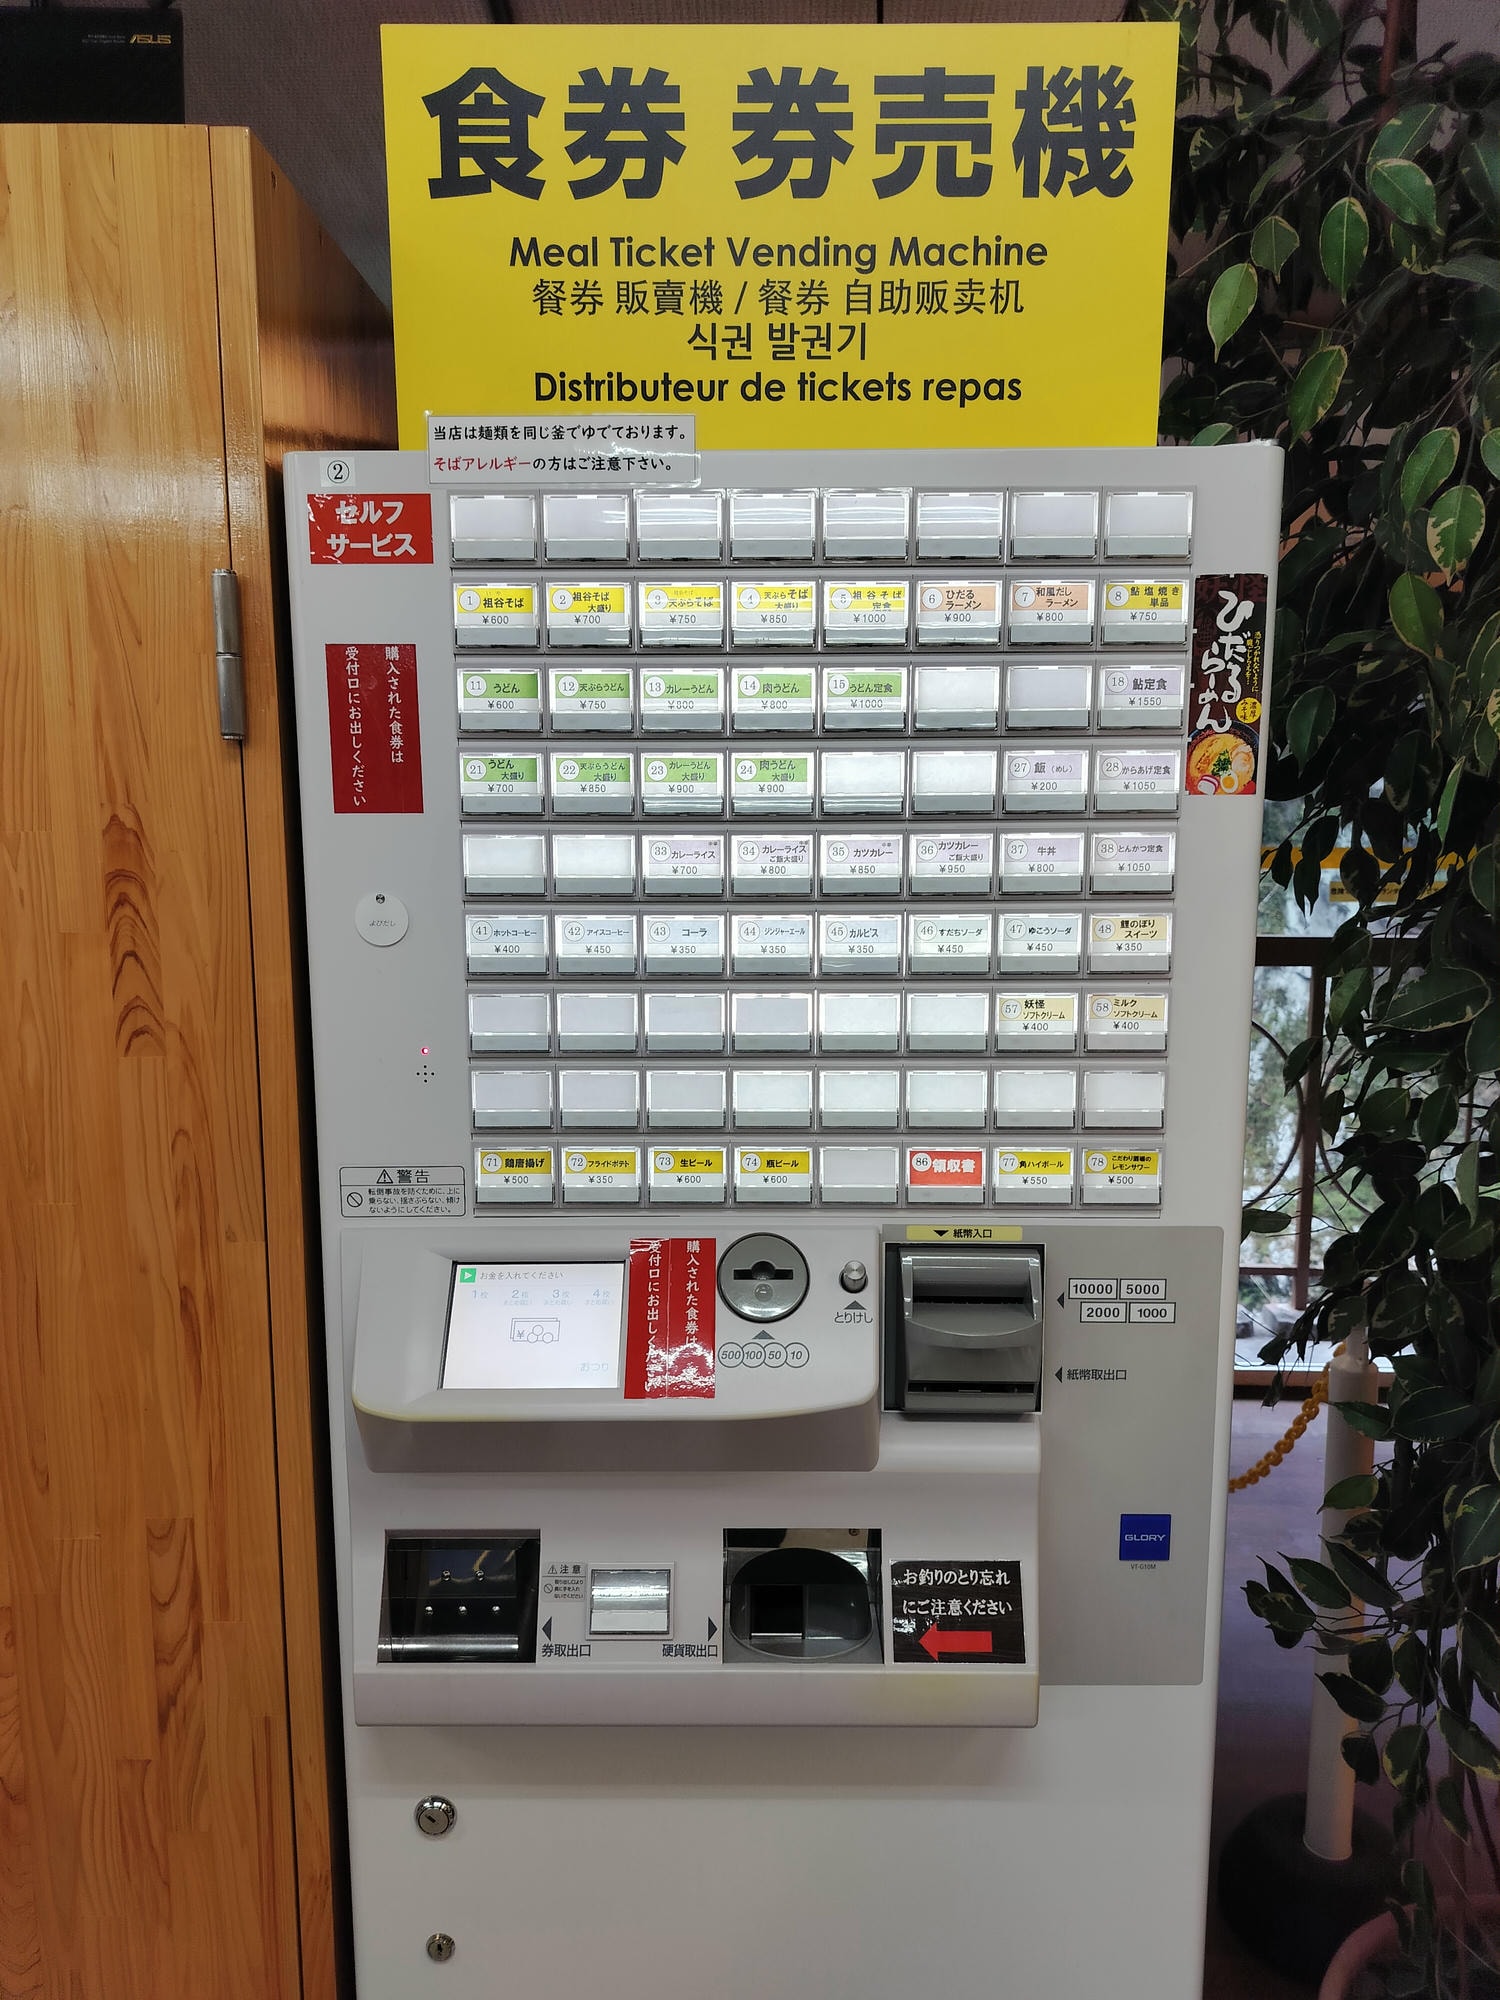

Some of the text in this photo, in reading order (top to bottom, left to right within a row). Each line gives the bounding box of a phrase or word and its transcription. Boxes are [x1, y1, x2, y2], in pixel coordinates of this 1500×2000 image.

[129, 34, 171, 44] ASUS
[421, 64, 1137, 200] 食券 券売機
[509, 235, 1048, 274] Meal Ticket Vending Machine
[532, 278, 604, 316] 餐券
[615, 279, 723, 316] 販賣機
[758, 278, 830, 315] 餐券
[845, 278, 1024, 315] 自助贩卖机
[687, 323, 866, 360] 식권 발권기
[535, 371, 1022, 409] Distributeur de tickets repas
[433, 425, 687, 441] 当店は麺類を同じ釜でゆでております。
[433, 456, 673, 472] そばアレルギーの方はご注意下さい。
[335, 500, 404, 525] セルフ
[327, 533, 416, 558] サービス
[764, 589, 808, 600] 天ぷらそば
[946, 589, 975, 600] ひだる
[1036, 587, 1072, 596] 和風だし
[572, 591, 610, 602] 祖谷そば
[483, 597, 524, 608] 祖谷そば
[945, 601, 981, 610] ラーメン
[1046, 599, 1078, 608] ラーメン
[587, 604, 612, 614] 大盛り
[482, 615, 509, 625] ¥600
[574, 615, 601, 625] ¥700
[669, 614, 697, 624] ¥750
[760, 614, 787, 624] ¥850
[853, 614, 886, 623] ¥1000
[944, 613, 972, 622] ¥900
[1037, 612, 1064, 621] ¥800
[1130, 612, 1157, 620] ¥750
[493, 683, 520, 694] うどん
[579, 682, 625, 693] 天ぷらうどん
[666, 683, 714, 694] カレーうどん
[762, 683, 800, 694] 肉うどん
[849, 683, 893, 694] うどん定食
[1132, 678, 1168, 690] 鮎定食
[385, 645, 404, 764] 購入された食券は
[487, 700, 514, 710] ¥600
[580, 700, 606, 710] ¥750
[1129, 697, 1162, 706] ¥1550
[345, 646, 366, 807] 受付口にお出しください
[488, 759, 514, 769] うどん
[580, 762, 626, 771] 天ぷらうどん
[669, 760, 711, 770] カレーうどん
[759, 760, 796, 770] 肉うどん
[1122, 764, 1171, 775] からあげ定食
[501, 772, 524, 780] 大盛り
[593, 773, 617, 782] 大盛り
[681, 772, 705, 781] 大盛り
[772, 772, 795, 782] 大盛り
[488, 784, 514, 792] ¥700
[580, 784, 606, 792] ¥850
[668, 784, 694, 793] ¥900
[758, 784, 784, 792] ¥900
[1032, 782, 1058, 790] ¥200
[1124, 782, 1156, 790] ¥1050
[762, 844, 807, 854] カレーライス
[938, 842, 978, 850] カツカレー
[1118, 844, 1164, 852] とんかつ定食
[672, 850, 716, 860] カレーライス
[853, 848, 893, 858] カツカレー
[672, 866, 698, 874] ¥700
[760, 866, 786, 874] ¥800
[850, 865, 876, 874] ¥850
[939, 864, 966, 874] ¥950
[1028, 864, 1054, 872] ¥800
[1118, 863, 1150, 872] ¥1050
[682, 928, 708, 937] コーラ
[938, 928, 983, 936] すだちソーダ
[1124, 930, 1158, 939] スイーツ
[494, 945, 520, 954] ¥400
[585, 946, 611, 954] ¥450
[670, 946, 696, 954] ¥350
[760, 946, 786, 954] ¥350
[848, 945, 874, 954] ¥350
[938, 945, 964, 954] ¥450
[1027, 943, 1054, 952] ¥450
[1116, 942, 1142, 951] ¥350
[1024, 1000, 1045, 1009] 妖怪
[1114, 998, 1137, 1008] ミルク
[1023, 1010, 1066, 1020] ソフトクリーム
[1114, 1010, 1158, 1018] ソフトクリーム
[1022, 1022, 1048, 1031] ¥400
[1113, 1022, 1140, 1030] ¥400
[588, 1160, 630, 1168] フライドポテト
[680, 1159, 712, 1168] 生ビール
[766, 1160, 799, 1168] 瓶ビール
[1020, 1160, 1064, 1168] 角ハイボール
[397, 1169, 430, 1184] 警告
[504, 1176, 529, 1184] ¥500
[588, 1176, 614, 1184] ¥350
[676, 1176, 702, 1184] ¥600
[762, 1176, 788, 1184] ¥600
[1022, 1176, 1048, 1184] ¥550
[1108, 1176, 1134, 1184] ¥500
[953, 1228, 992, 1239] 紙幣入口
[480, 1272, 564, 1280] お金を入れてください
[684, 1240, 700, 1347] 購入された食券は
[1072, 1284, 1160, 1296] 10000 5000
[1086, 1306, 1168, 1318] 2000 1000
[834, 1310, 874, 1324] とりけし
[721, 1350, 802, 1360] 500 100 50 10
[1067, 1368, 1127, 1381] 紙幣取出口
[1124, 1534, 1166, 1542] GLORY
[903, 1569, 1011, 1586] お釣りのとり忘れ
[903, 1599, 1012, 1616] にご注意ください
[542, 1644, 591, 1658] 券取出口
[662, 1644, 718, 1658] 硬貨取出口
